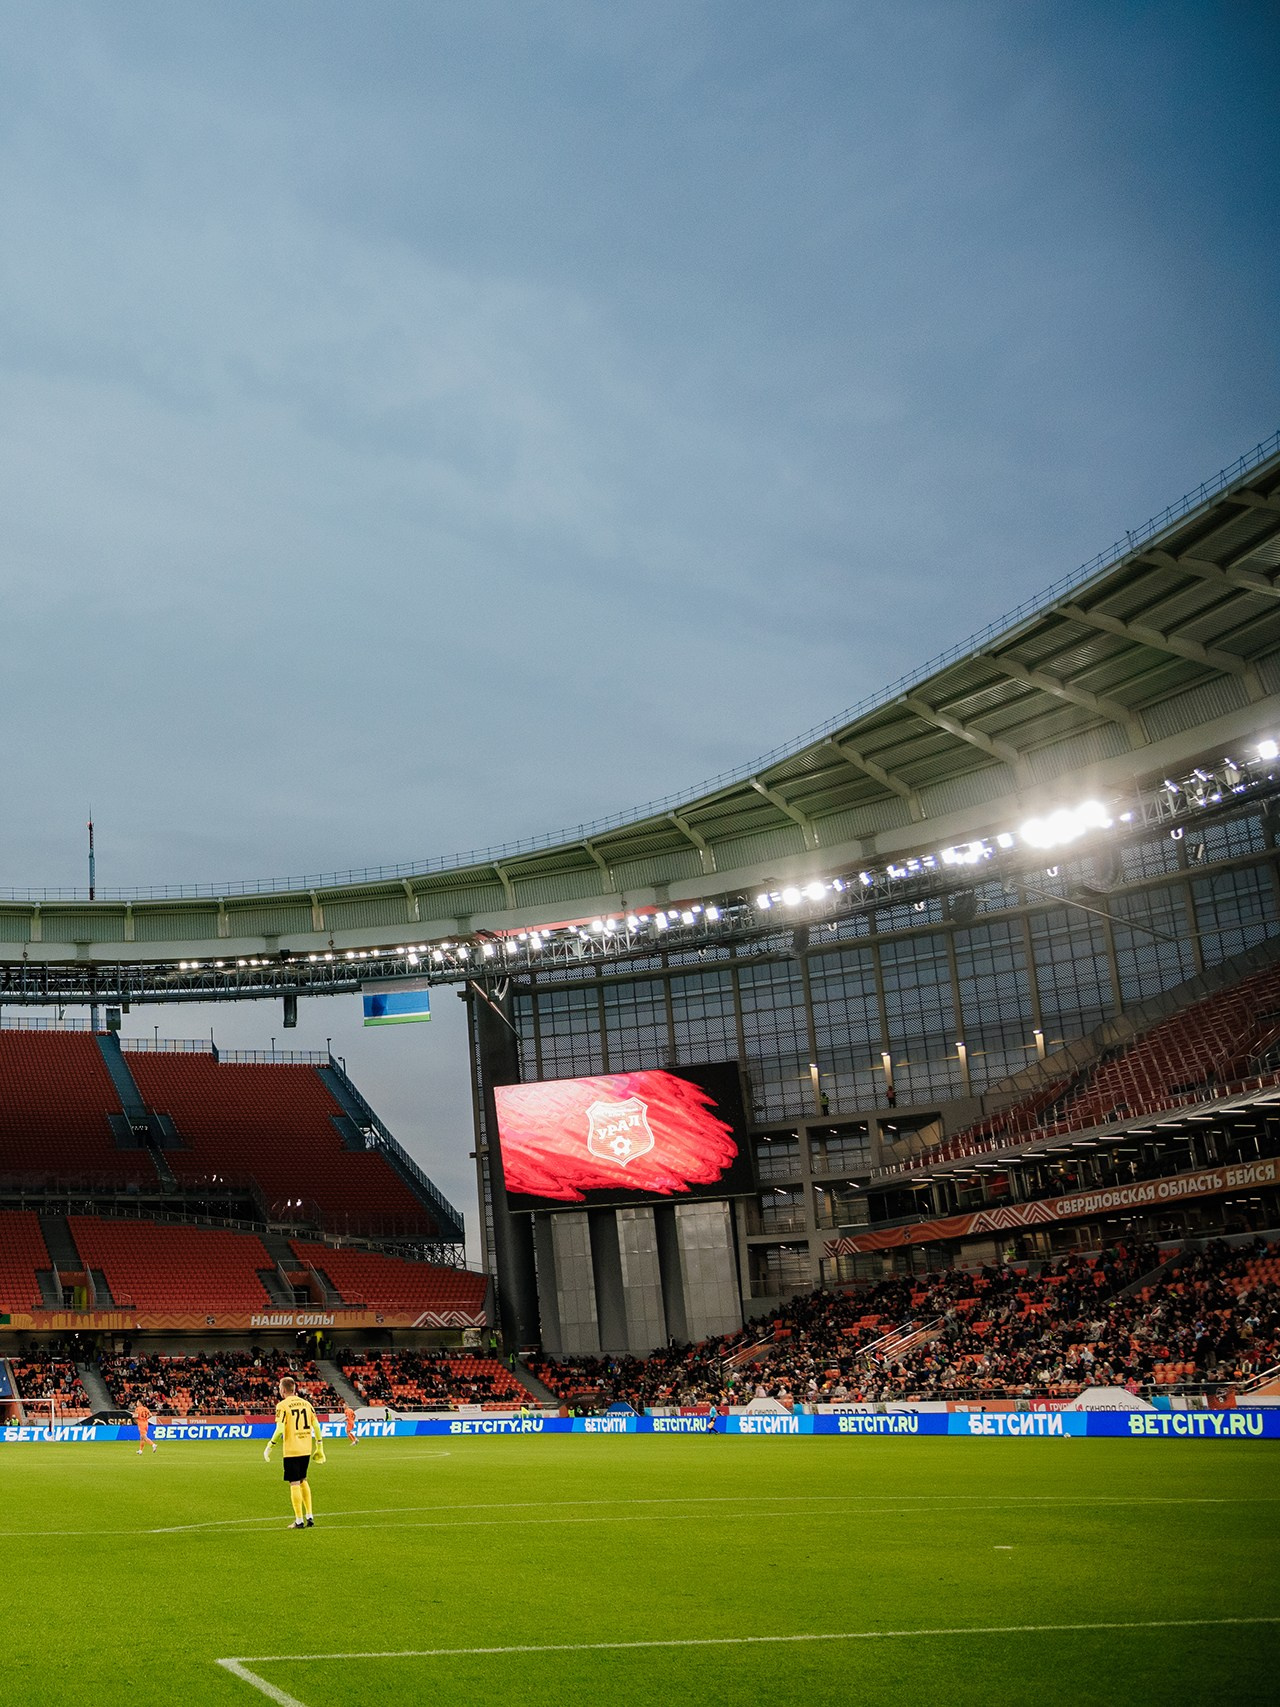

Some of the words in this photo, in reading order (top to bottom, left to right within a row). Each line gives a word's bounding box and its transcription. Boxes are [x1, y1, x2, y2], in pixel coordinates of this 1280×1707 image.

[596, 1115, 640, 1139] УРАЛ
[1056, 1185, 1156, 1215] СВЕРДЛОВСКАЯ
[1158, 1175, 1222, 1197] ОБЛАСТЬ
[1226, 1164, 1276, 1186] БЕЙСЯ
[250, 1315, 293, 1326] НАШИ
[296, 1315, 335, 1326] СИЛЫ
[291, 1408, 310, 1430] 71
[450, 1419, 544, 1434] BETCITY.RU
[584, 1418, 626, 1432] БЕТСИТИ
[653, 1417, 707, 1432] BETCITY.RU
[739, 1416, 799, 1433] БЕТСИТИ
[838, 1416, 919, 1433] BETCITY.RU
[968, 1414, 1063, 1435] БЕТСИТИ
[1128, 1413, 1263, 1436] BETCITY.RU
[3, 1427, 96, 1441] БЕТСИТИ
[153, 1426, 252, 1439] BETCITY.RU
